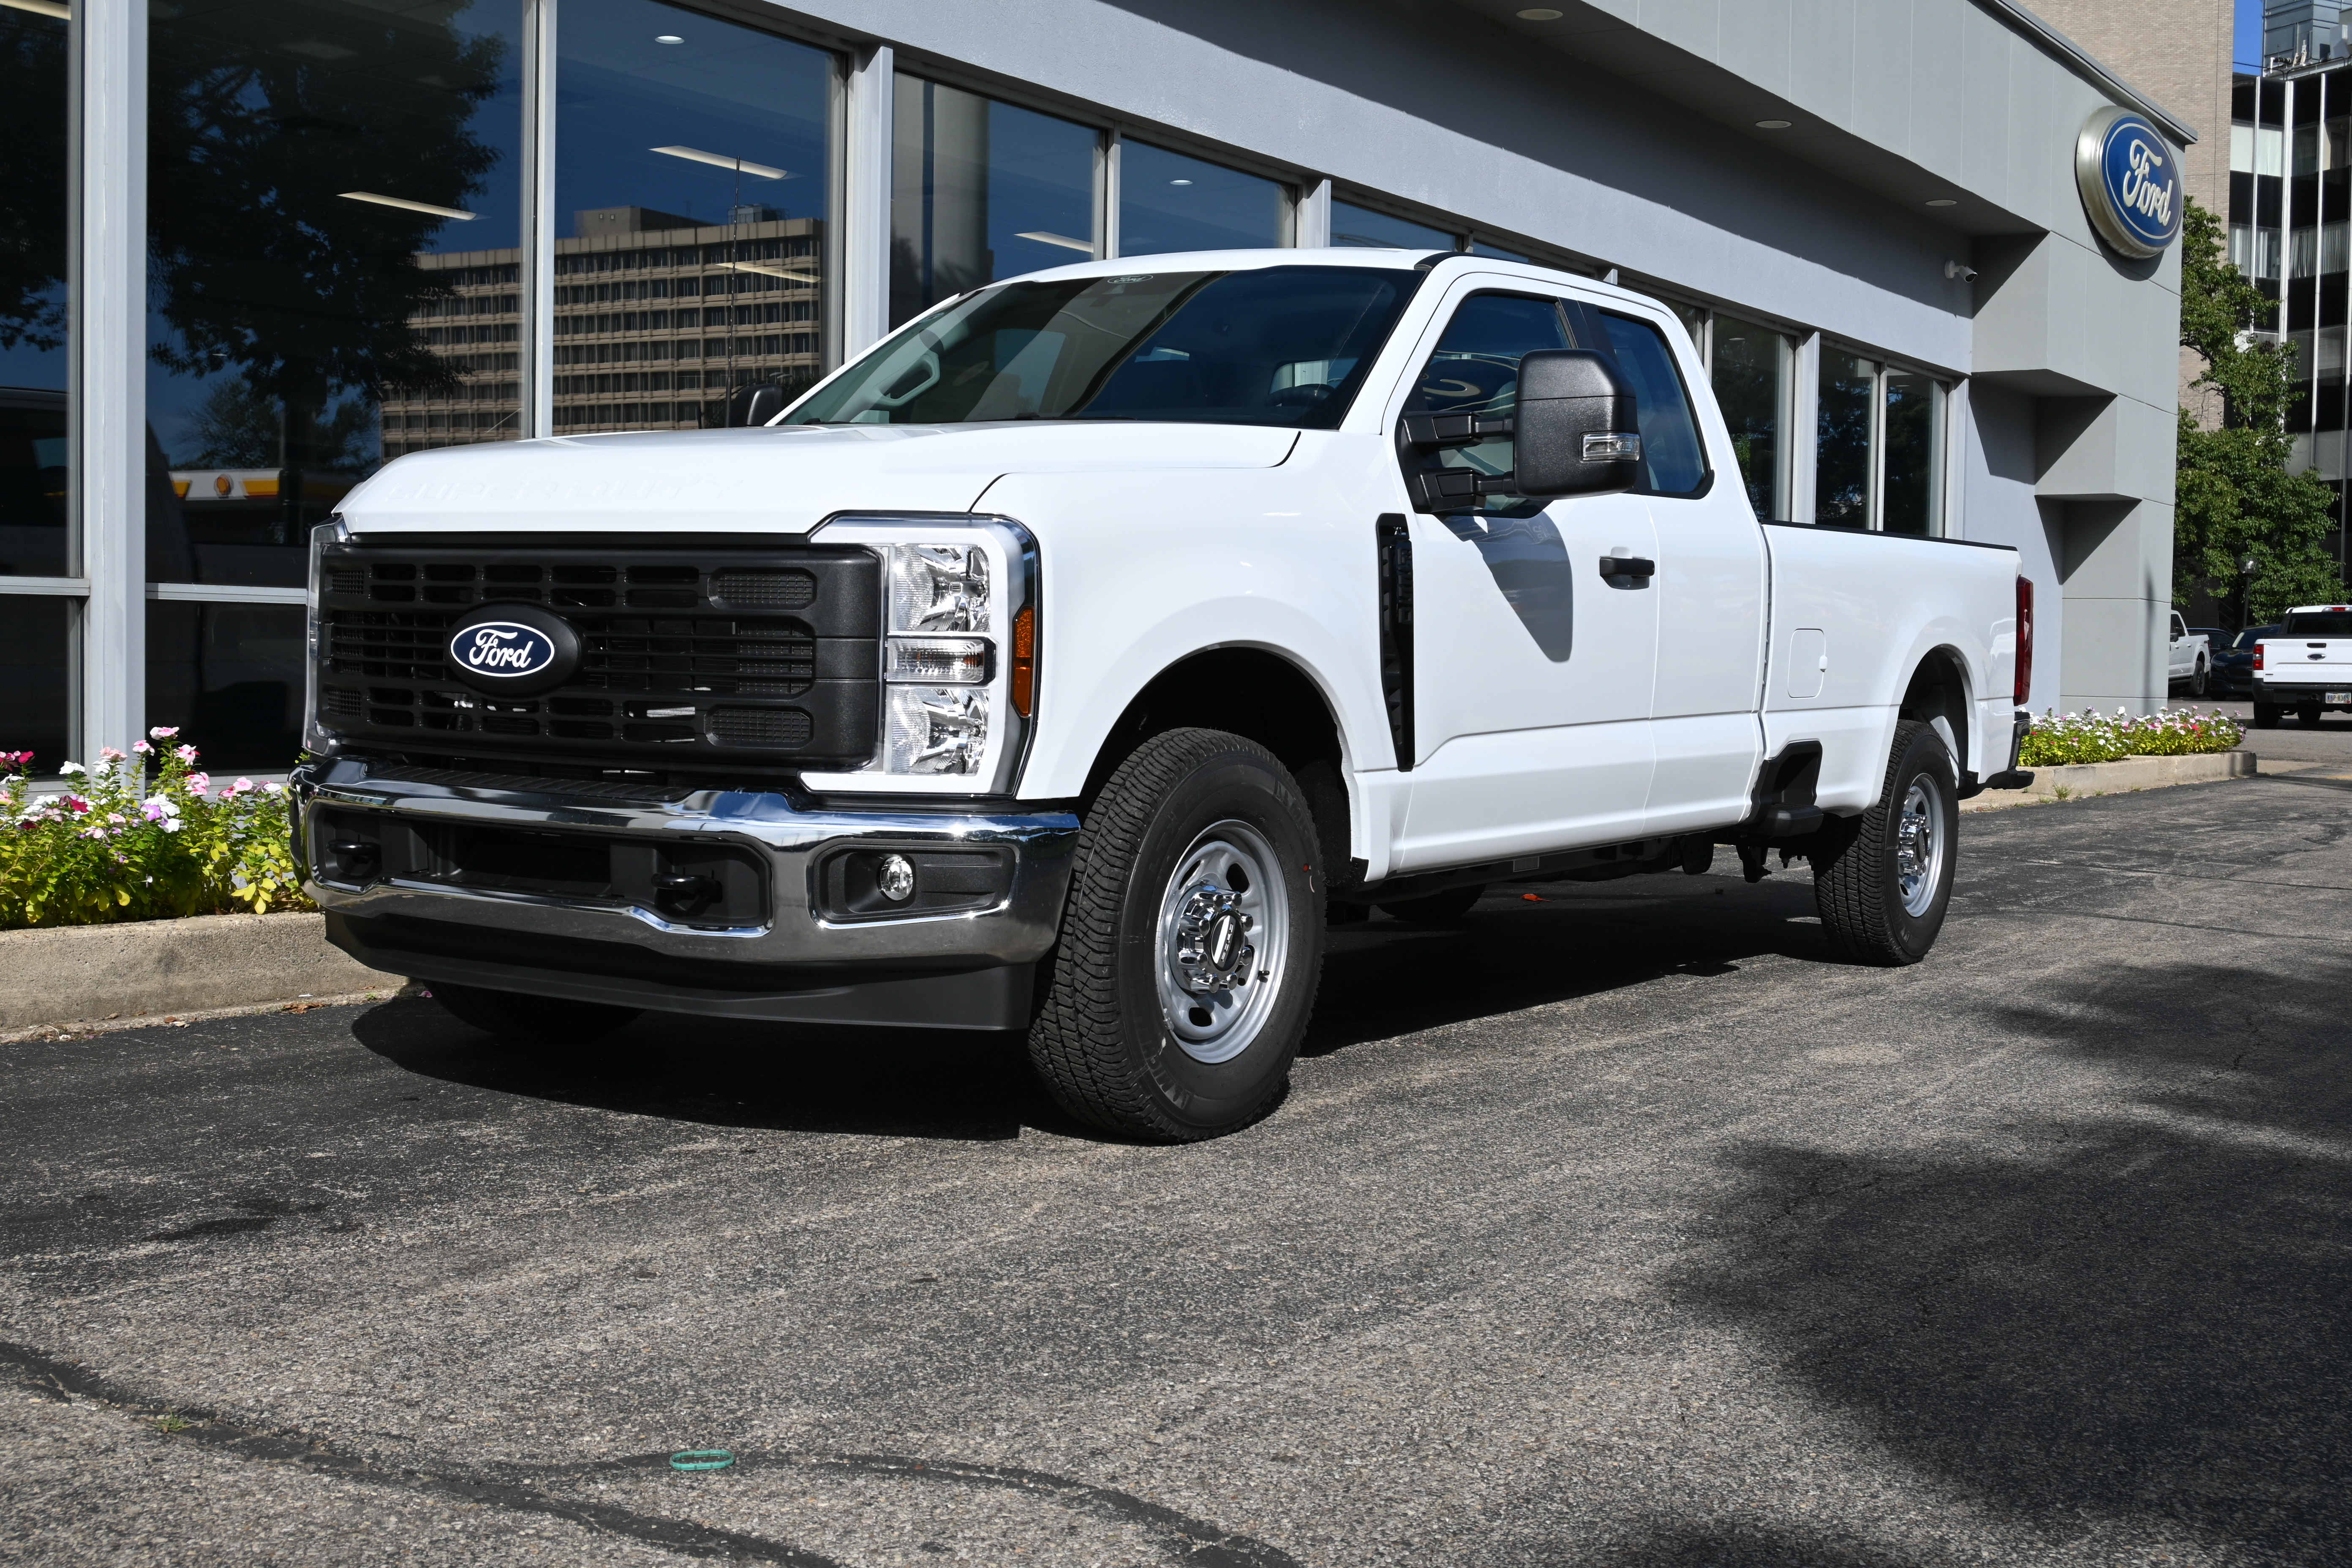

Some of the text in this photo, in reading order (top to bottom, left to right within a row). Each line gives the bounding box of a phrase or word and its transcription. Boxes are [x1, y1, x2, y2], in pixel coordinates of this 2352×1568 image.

[2123, 139, 2172, 226] Ford
[384, 479, 744, 502] SUPER DUTY
[469, 629, 533, 668] Ford
